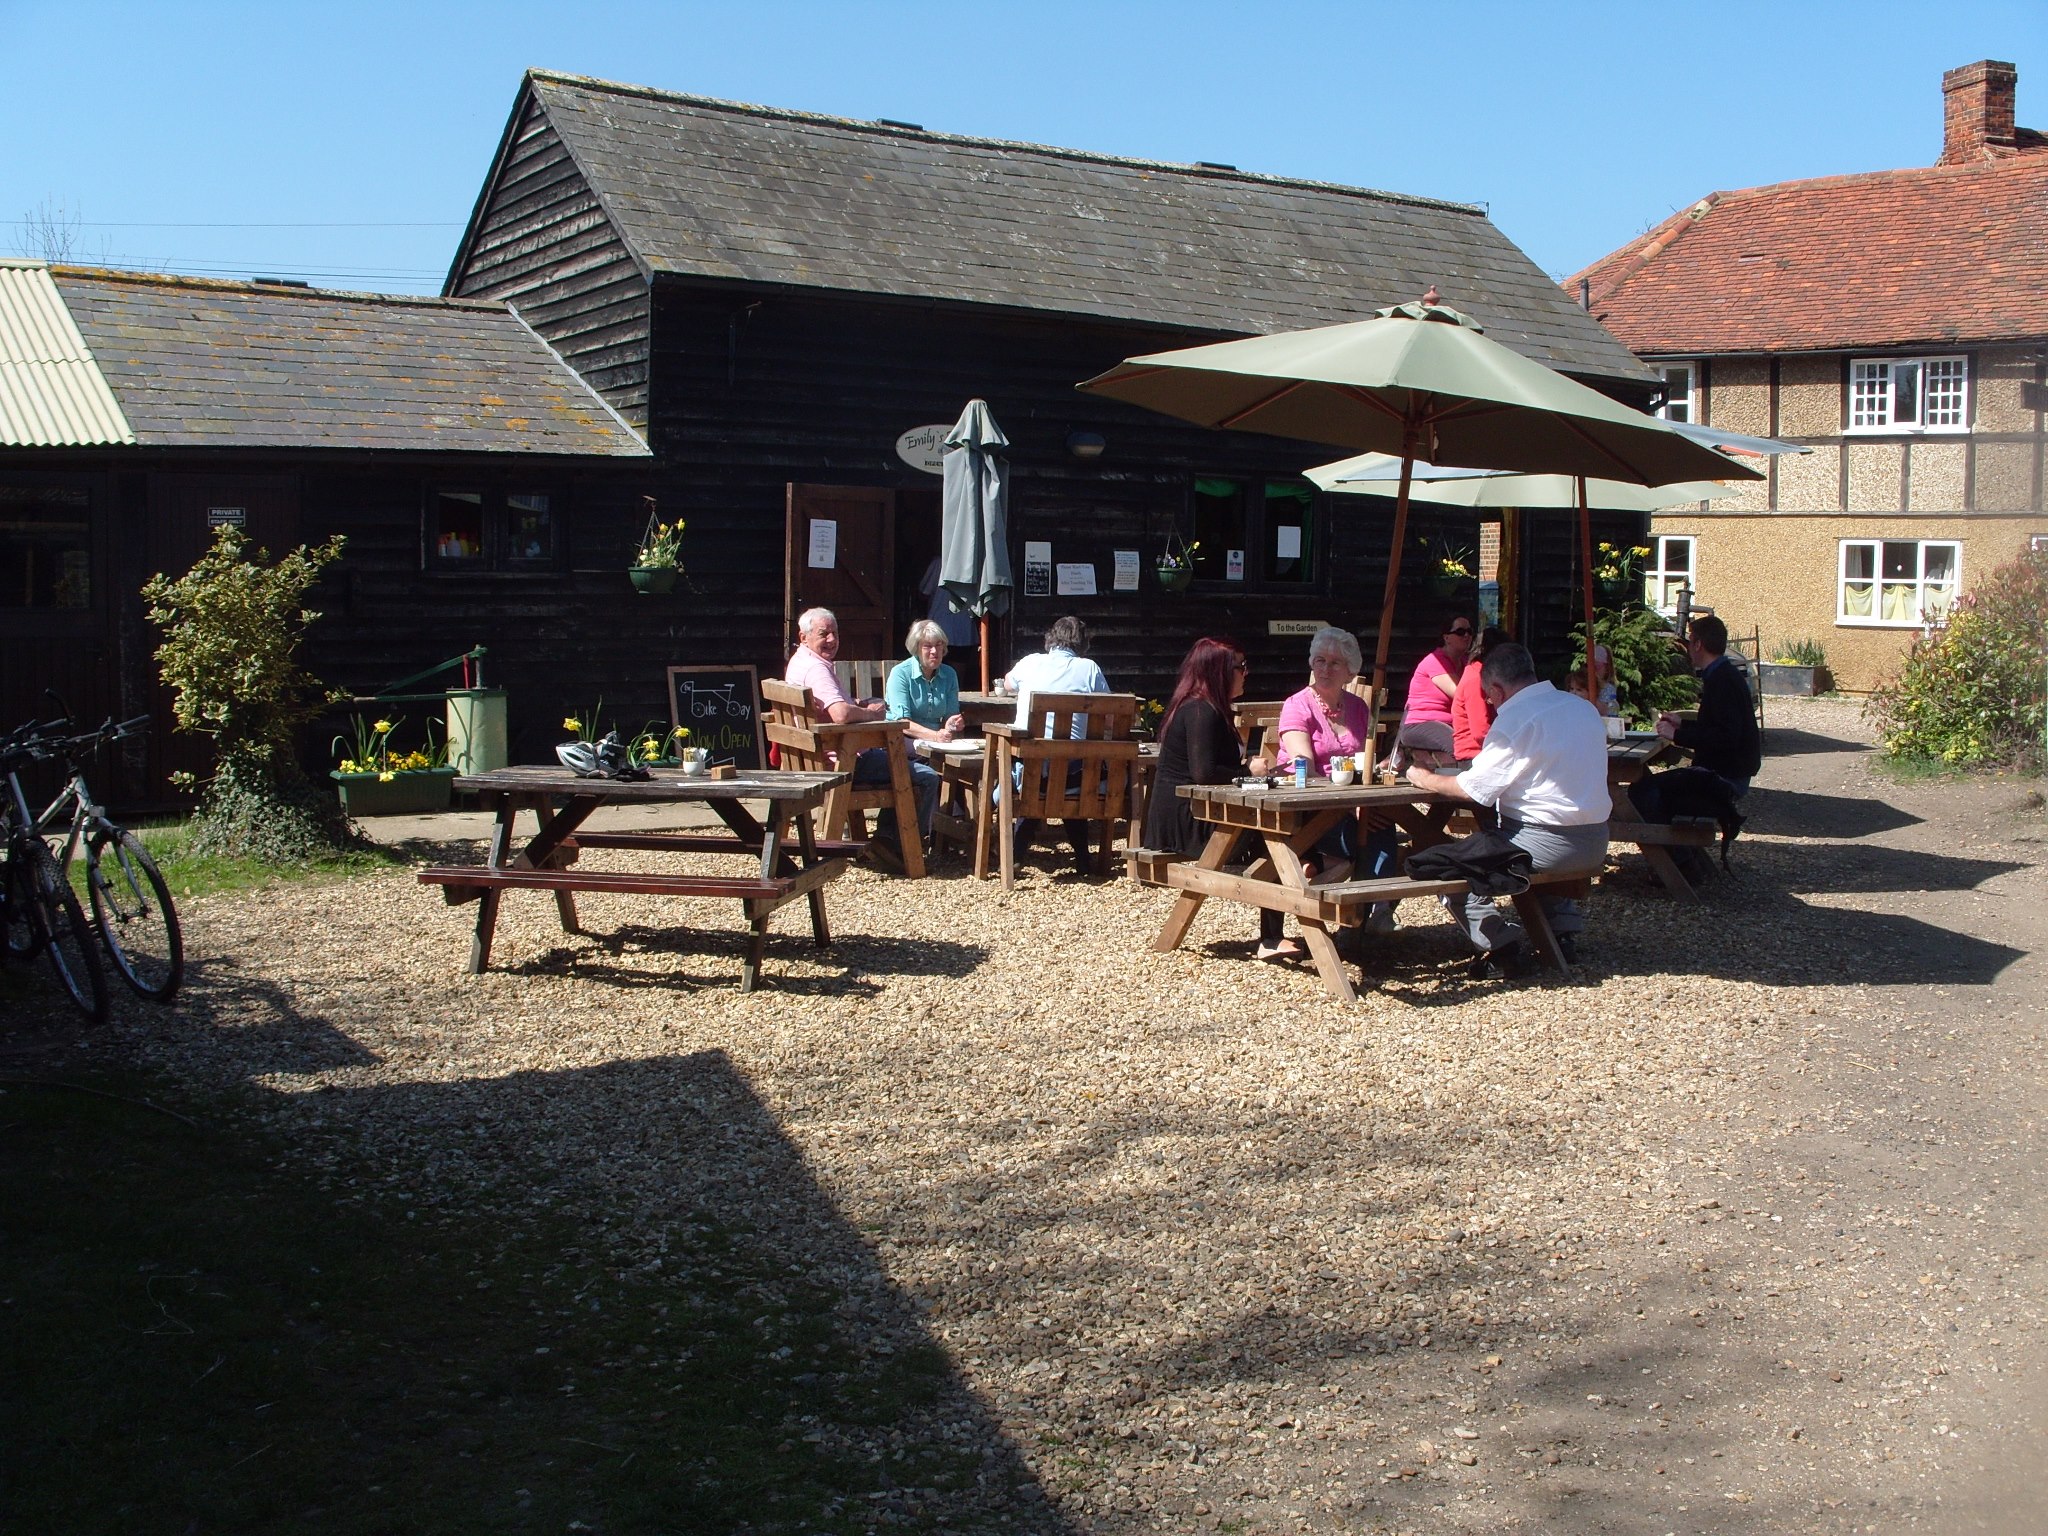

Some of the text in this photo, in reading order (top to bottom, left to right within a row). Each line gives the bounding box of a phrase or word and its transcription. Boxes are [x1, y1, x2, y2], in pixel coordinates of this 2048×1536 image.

[1277, 623, 1318, 632] To the Garden
[721, 724, 752, 750] OPEN
